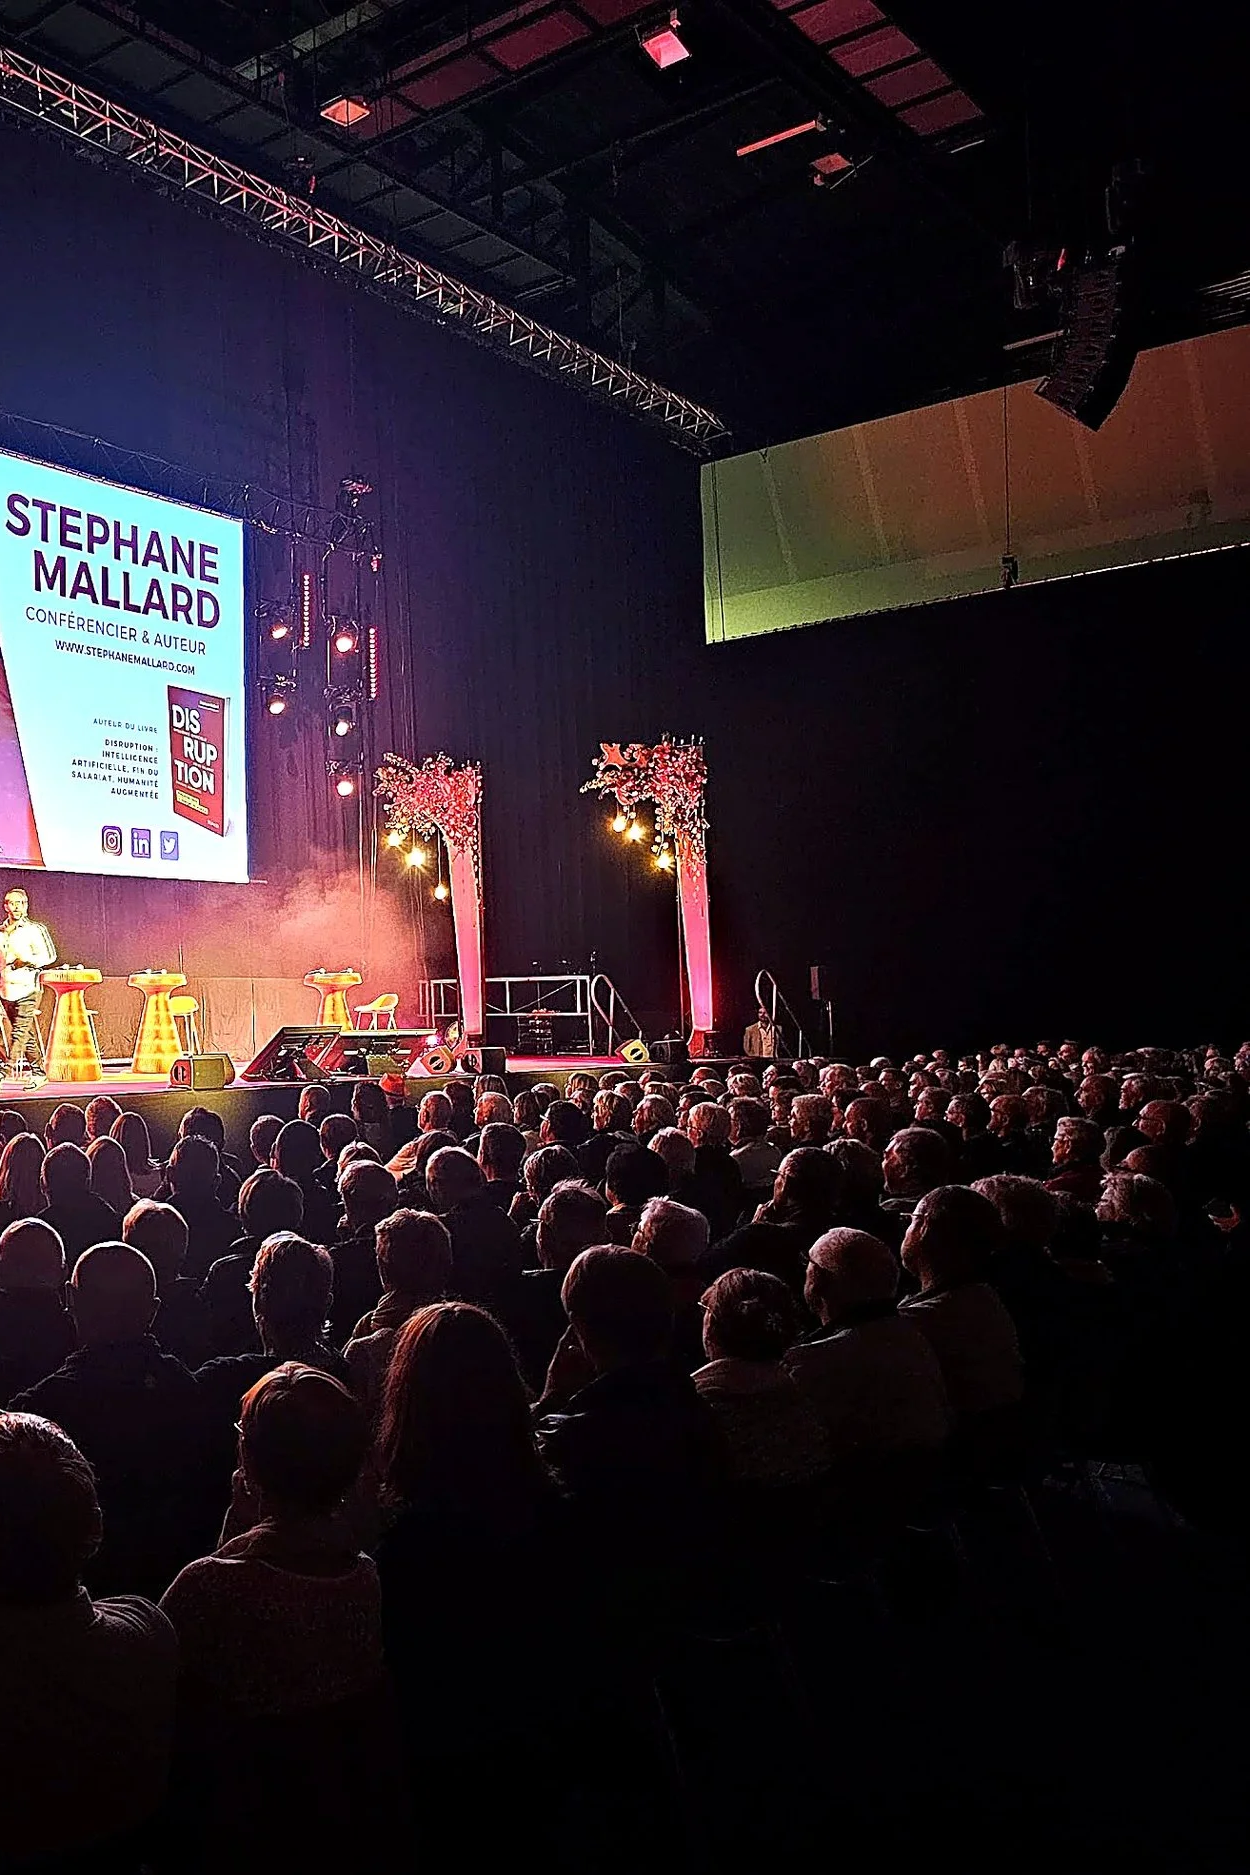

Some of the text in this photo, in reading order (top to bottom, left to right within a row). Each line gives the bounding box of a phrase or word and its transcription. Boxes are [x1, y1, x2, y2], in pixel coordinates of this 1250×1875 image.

[6, 493, 219, 584] STEPHANE
[34, 549, 220, 629] MALLARD
[25, 607, 206, 655] CONFÉRENCIER & AUTEUR
[55, 639, 195, 675] WWW.STEPHANEMALLARD.COM
[93, 718, 158, 734] AUTEUR DU LIVRE
[171, 704, 201, 735] DIS
[102, 750, 158, 764] INTELLIGENCE
[105, 739, 153, 752] DISRUPTION
[183, 736, 218, 767] RUP
[132, 766, 145, 775] FIN
[148, 768, 159, 777] DU
[173, 759, 215, 795] TION
